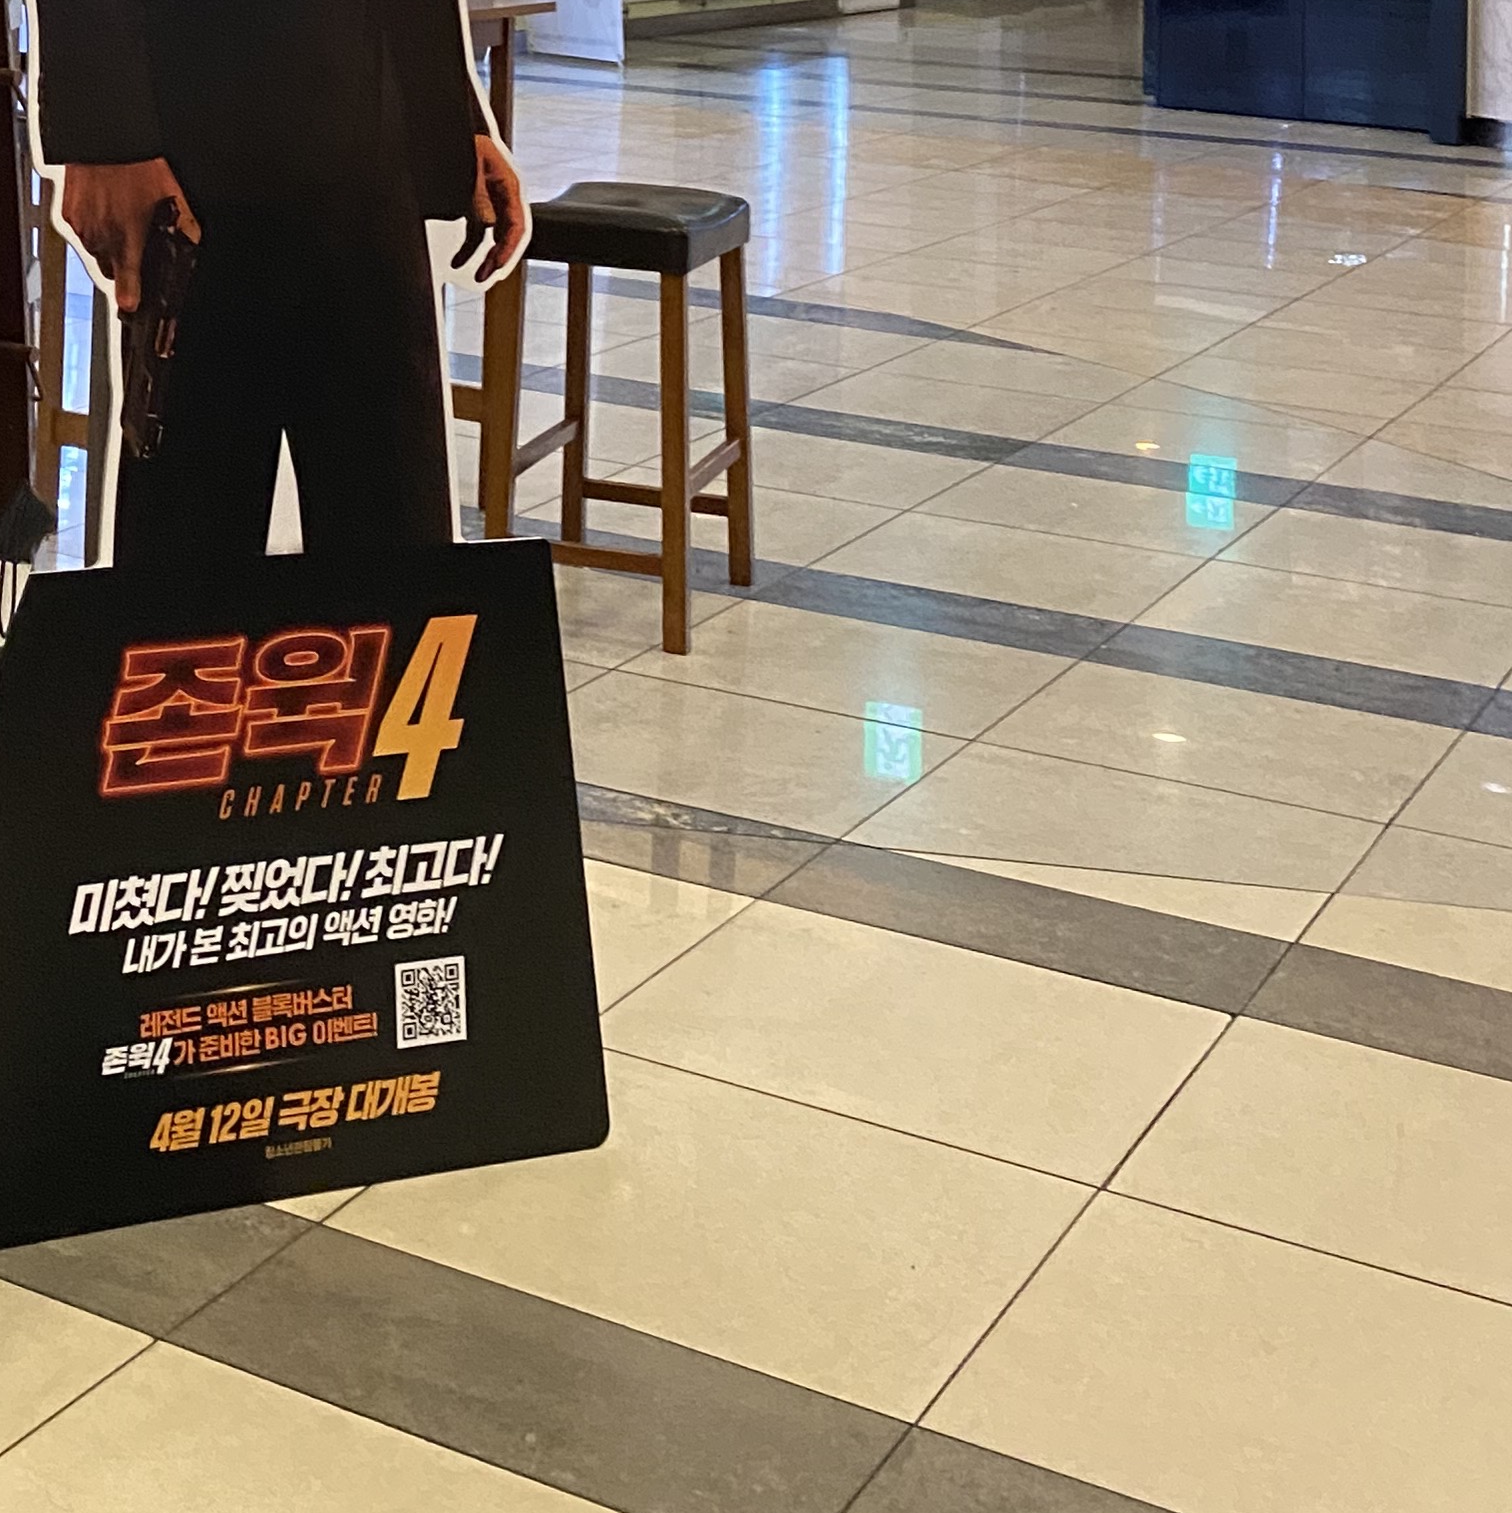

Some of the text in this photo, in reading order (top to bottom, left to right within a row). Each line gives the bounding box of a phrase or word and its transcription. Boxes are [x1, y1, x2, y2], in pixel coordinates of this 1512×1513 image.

[219, 774, 383, 820] CHAPTER
[68, 834, 504, 935] 미쳤다! 찢었다! 최고다!
[122, 896, 458, 974] 내가 본 최고의 액션 영화!
[139, 984, 353, 1038] 레전드 액션 블록버스터
[199, 1028, 262, 1062] 준비한
[264, 1022, 307, 1050] BIG
[312, 1012, 378, 1044] 이벤트!
[149, 1071, 441, 1153] 4월 12일 극장 대개봉
